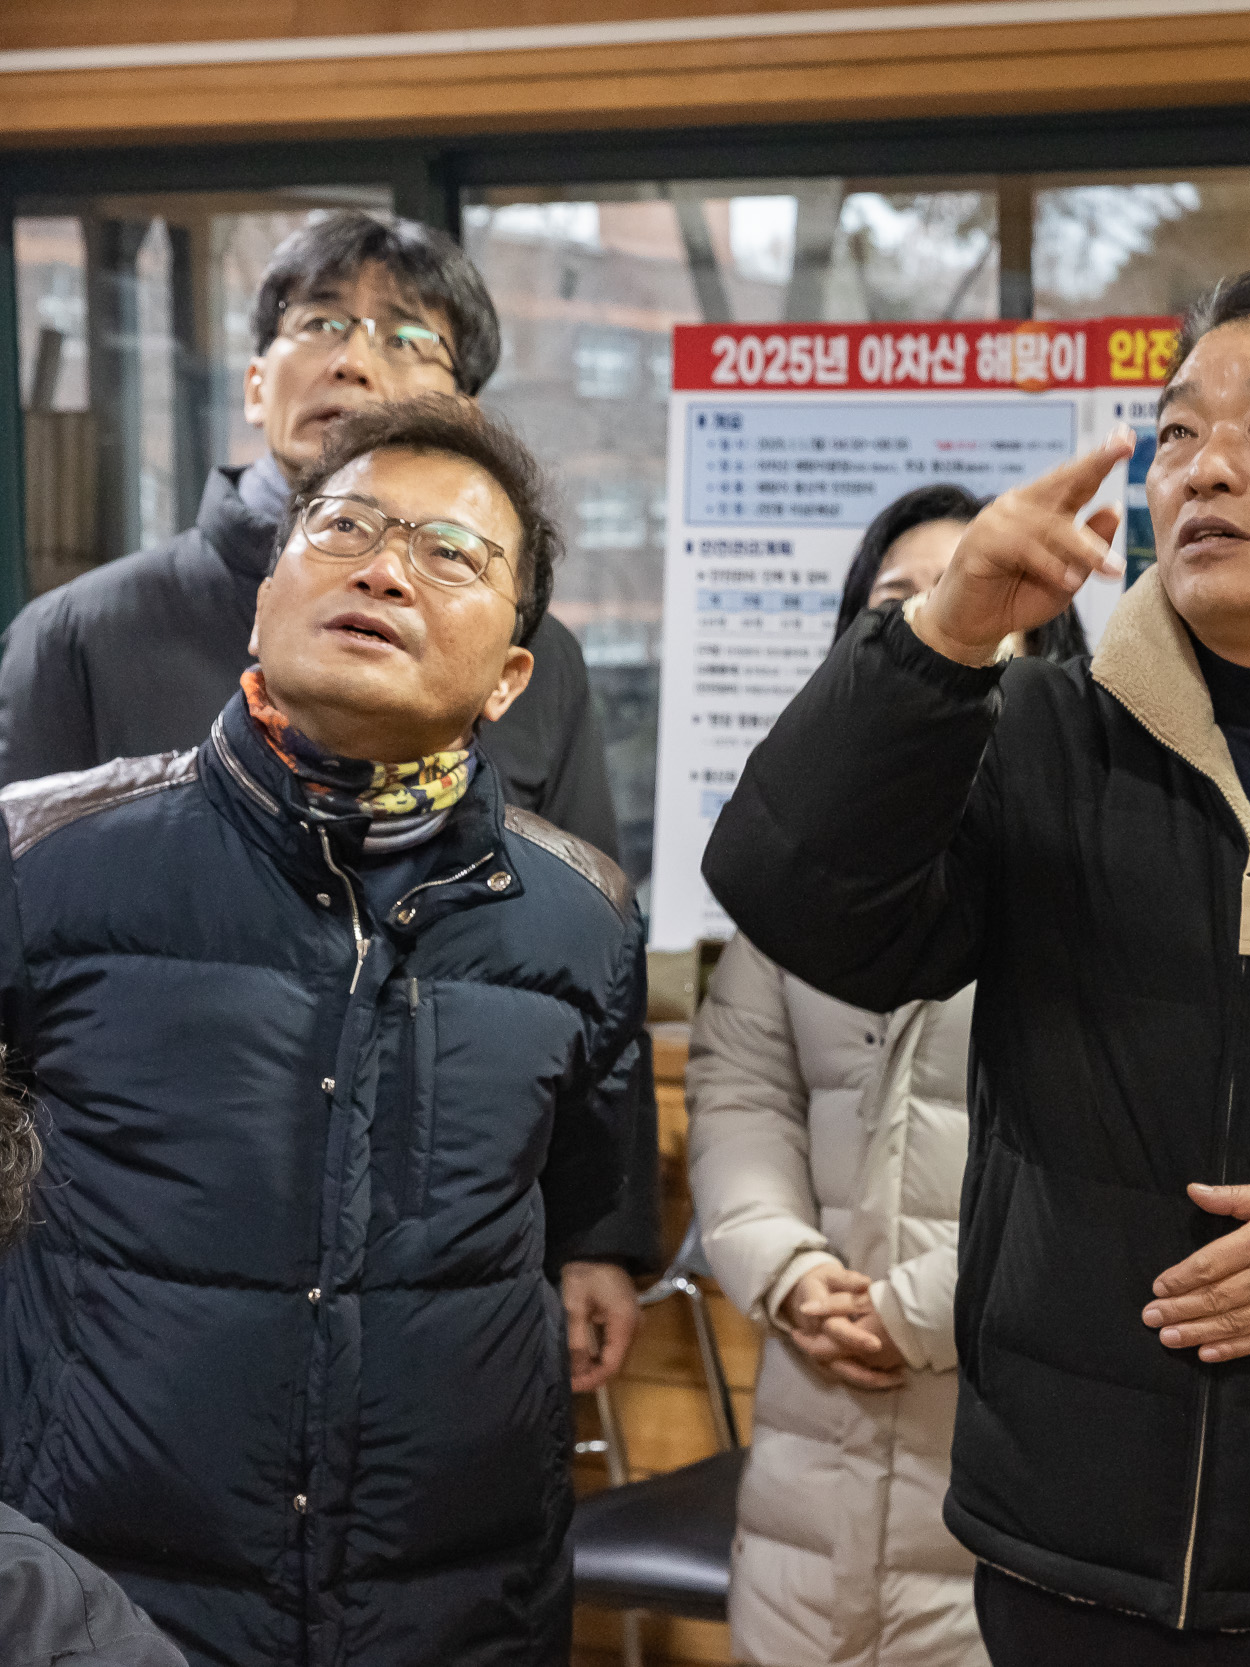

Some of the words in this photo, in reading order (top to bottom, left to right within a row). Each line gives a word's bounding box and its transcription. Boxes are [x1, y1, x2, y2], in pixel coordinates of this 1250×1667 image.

[711, 334, 848, 384] 2025년
[859, 333, 967, 383] 아차산
[976, 332, 1086, 383] 해맞이
